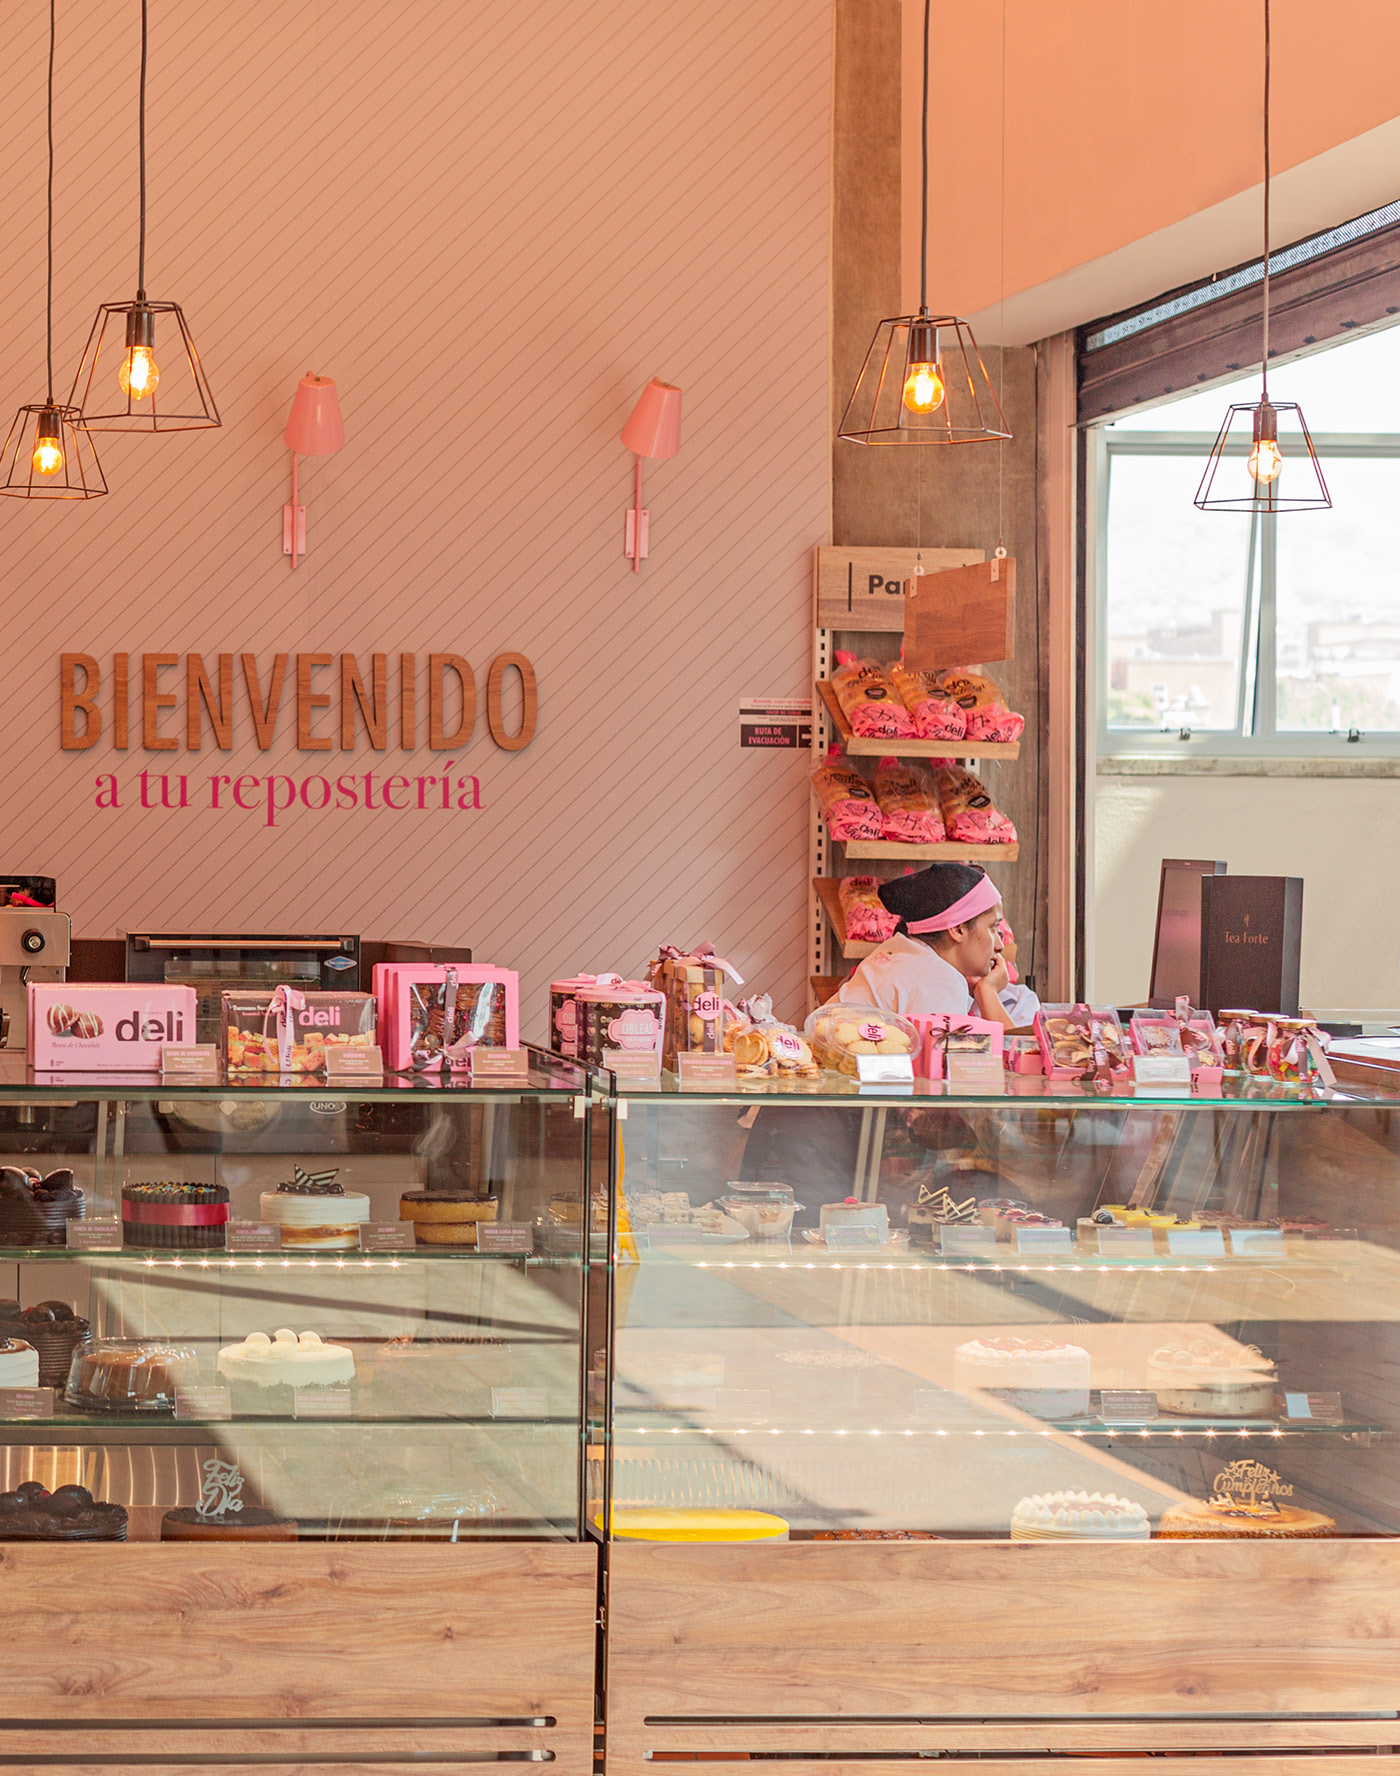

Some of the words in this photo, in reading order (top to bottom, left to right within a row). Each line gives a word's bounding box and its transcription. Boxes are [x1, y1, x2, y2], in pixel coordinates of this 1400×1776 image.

[60, 651, 538, 752] BIENVENIDO
[755, 727, 772, 736] RUTA
[774, 727, 782, 736] DE
[944, 723, 964, 738] deli
[748, 735, 790, 745] EVACUACIÓN
[94, 773, 124, 809] a
[139, 769, 193, 809] tu
[206, 760, 486, 827] repostería
[1225, 931, 1240, 943] Tea
[694, 997, 720, 1011] deli
[298, 1006, 341, 1026] deli
[447, 1007, 455, 1023] deli
[115, 1011, 185, 1042] deli
[622, 1022, 654, 1034] OBLEAS
[706, 1022, 715, 1039] deli
[75, 1041, 101, 1049] Chocolate
[777, 1035, 800, 1050] deli
